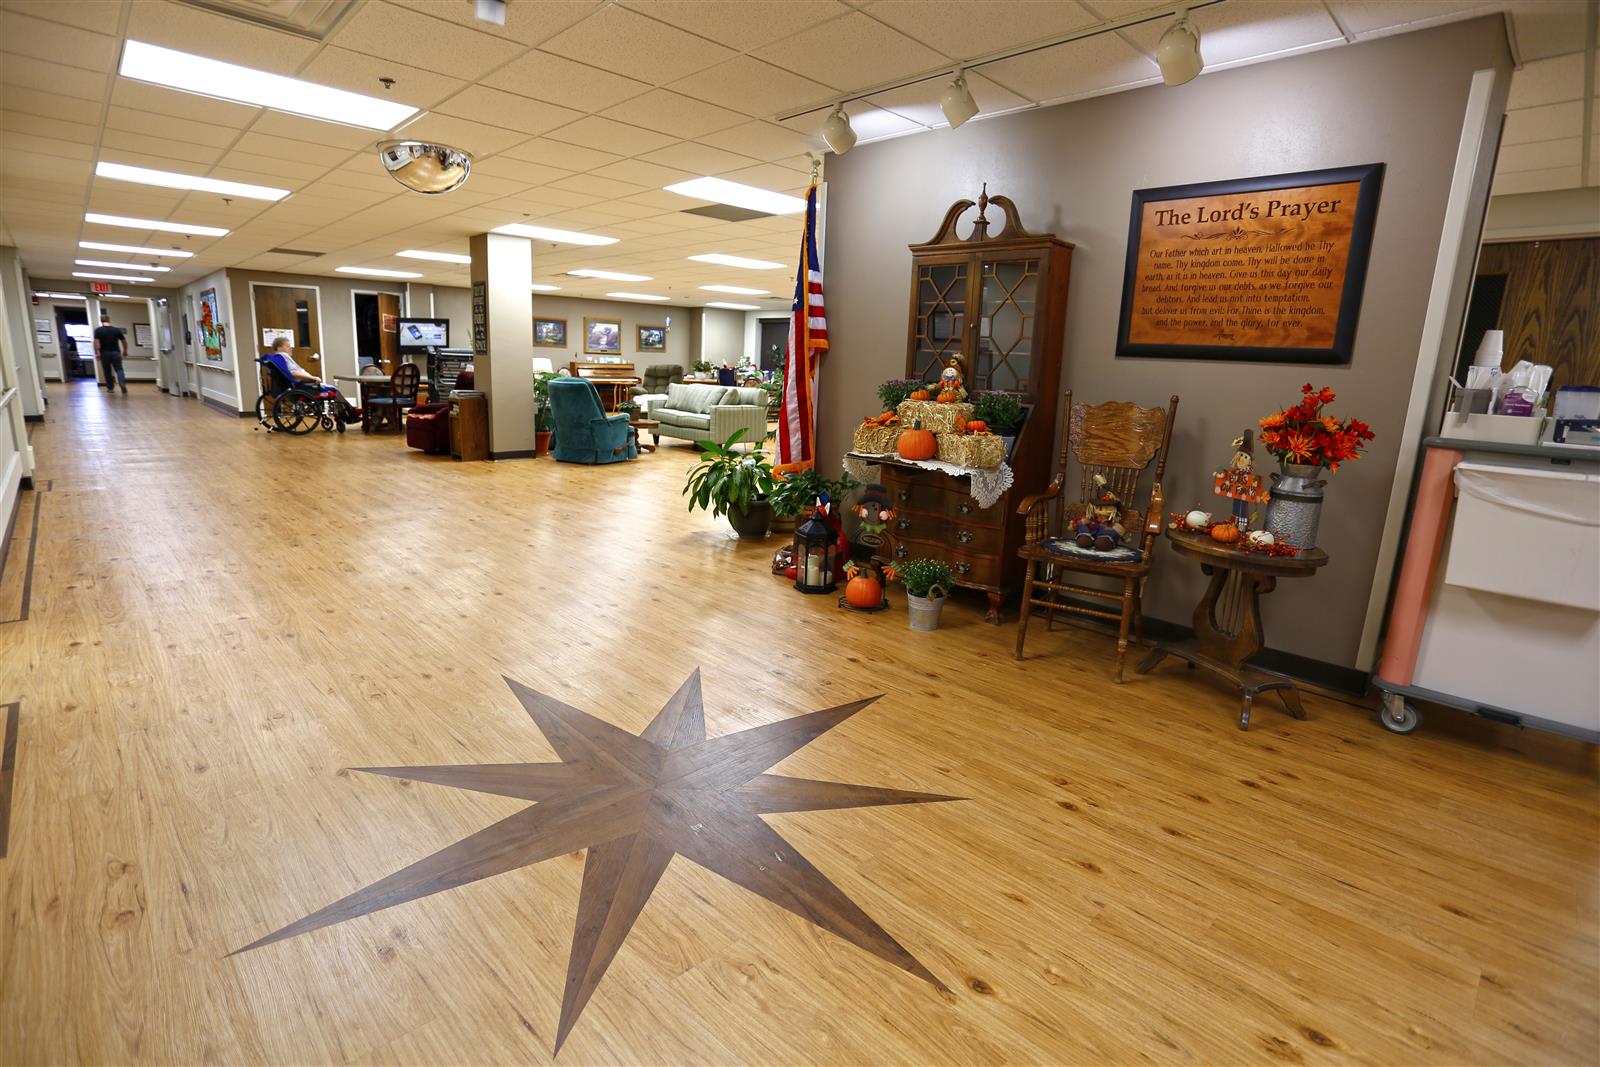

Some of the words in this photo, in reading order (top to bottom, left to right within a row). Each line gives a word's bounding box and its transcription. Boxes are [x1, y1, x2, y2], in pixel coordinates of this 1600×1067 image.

[1155, 209, 1191, 227] The
[1197, 202, 1259, 224] Lord's
[1266, 199, 1342, 221] Prayer
[1150, 249, 1163, 258] Our
[1165, 249, 1187, 257] Father
[1189, 248, 1209, 256] which
[1211, 247, 1223, 255] art
[1225, 247, 1232, 255] in
[1266, 242, 1302, 252] Hallowed
[1305, 242, 1315, 250] be
[1320, 240, 1335, 254] Thy
[1176, 260, 1189, 271] Thy
[1190, 259, 1220, 270] kingdom
[1248, 257, 1261, 269] Thy
[1264, 256, 1278, 264] will
[1280, 256, 1290, 264] be
[1293, 255, 1314, 264] done
[1175, 272, 1181, 280] it
[1230, 270, 1248, 278] Give
[1260, 269, 1274, 278] this
[1277, 269, 1292, 280] day
[1312, 266, 1333, 279] daily
[93, 282, 109, 292] EXIT
[1165, 284, 1178, 292] And
[1181, 284, 1207, 293] forgive
[1285, 281, 1315, 291] forgive
[1319, 281, 1333, 289] our
[1186, 295, 1201, 303] And
[1203, 295, 1218, 303] lead
[1230, 294, 1243, 302] not
[1245, 294, 1261, 302] into
[1154, 307, 1178, 315] deliver
[1190, 307, 1207, 315] from
[1242, 305, 1262, 314] Thine
[1156, 319, 1168, 327] and
[1210, 318, 1224, 327] and
[1226, 318, 1238, 326] the
[1267, 318, 1280, 328] for
